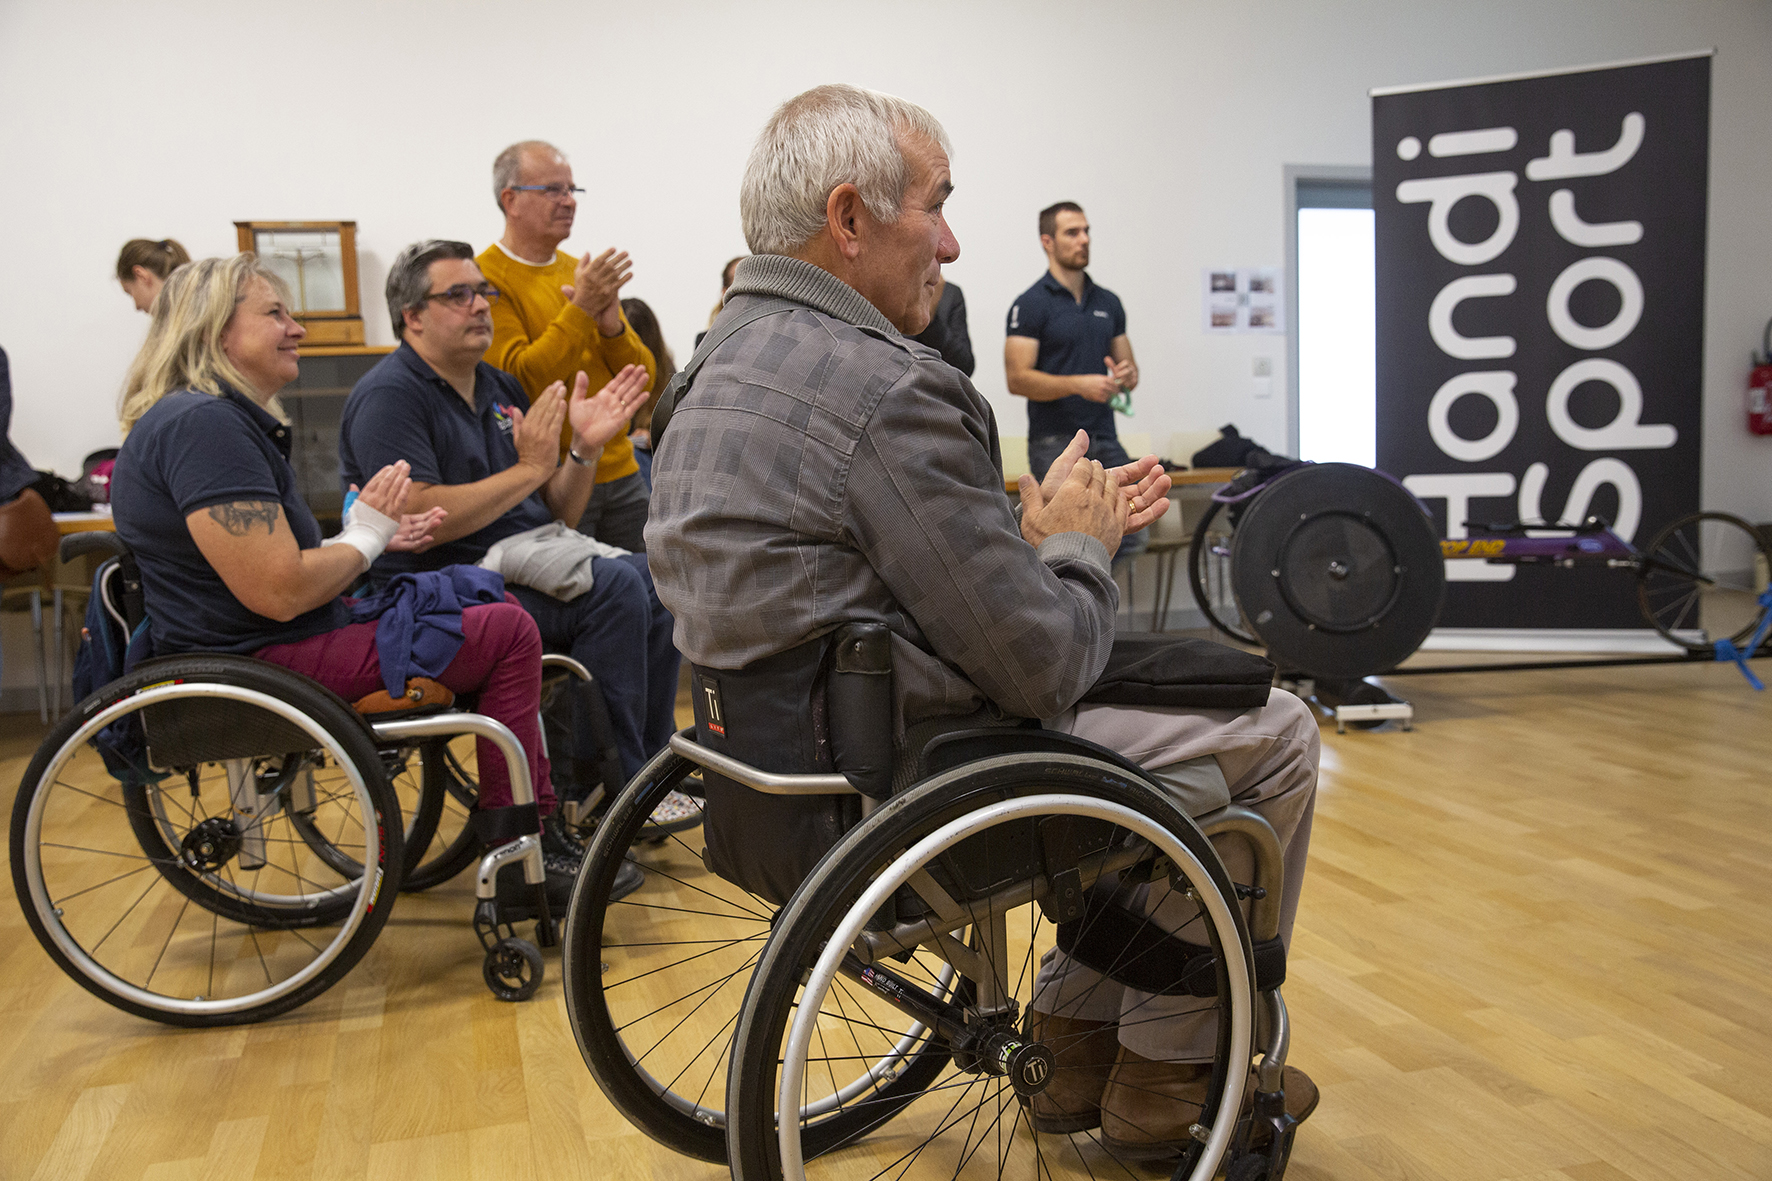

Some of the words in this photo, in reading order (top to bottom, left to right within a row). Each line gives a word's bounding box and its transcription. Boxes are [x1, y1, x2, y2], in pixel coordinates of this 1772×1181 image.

[1396, 126, 1520, 582] Handi
[704, 687, 720, 721] Ti
[1027, 1059, 1045, 1082] Ti
